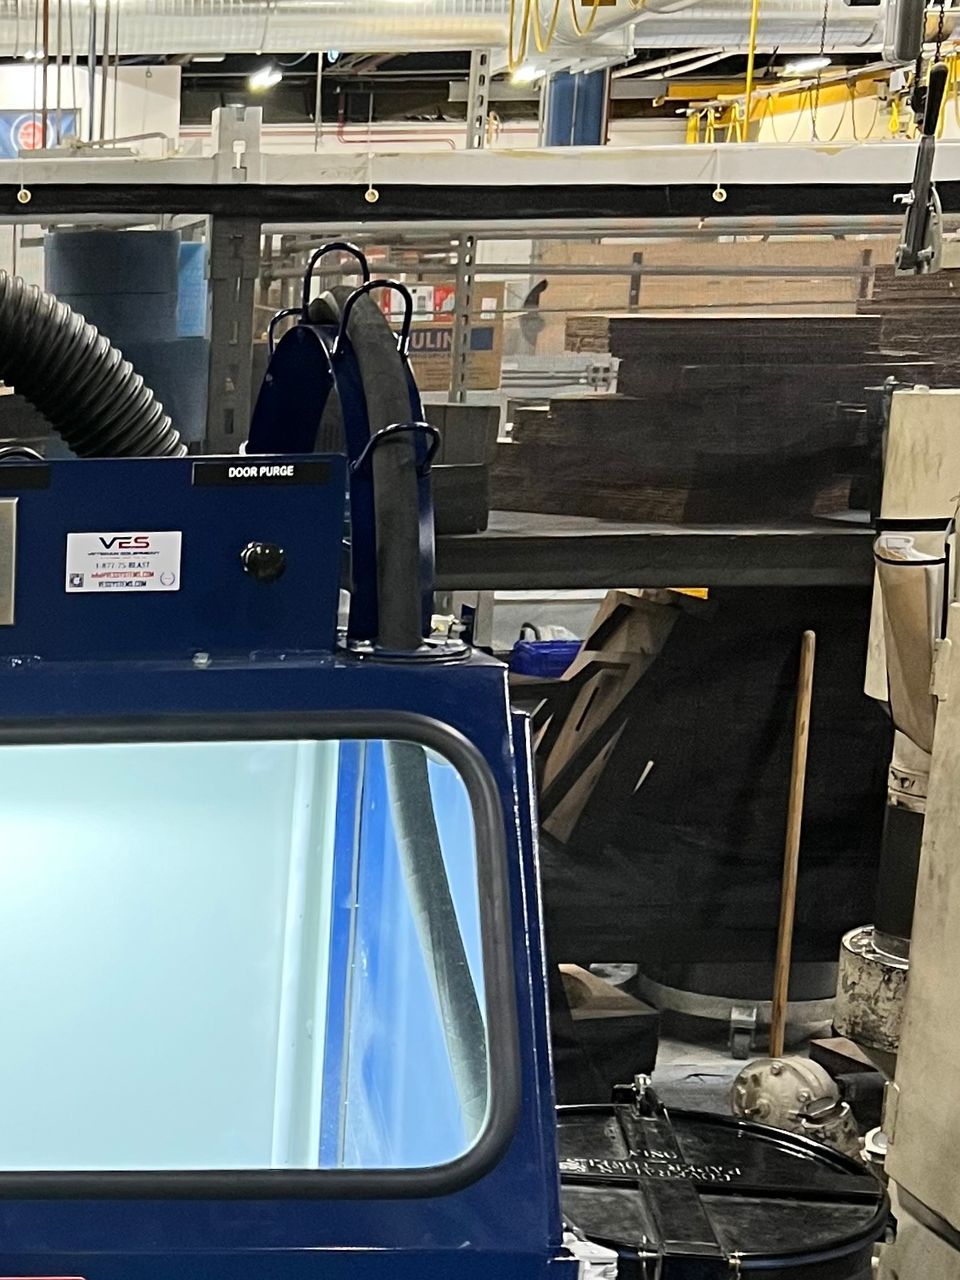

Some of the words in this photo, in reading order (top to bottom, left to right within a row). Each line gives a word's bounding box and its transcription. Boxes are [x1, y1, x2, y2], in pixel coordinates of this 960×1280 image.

[228, 466, 258, 478] DOOR
[259, 465, 294, 477] PURGE
[99, 536, 150, 549] VES
